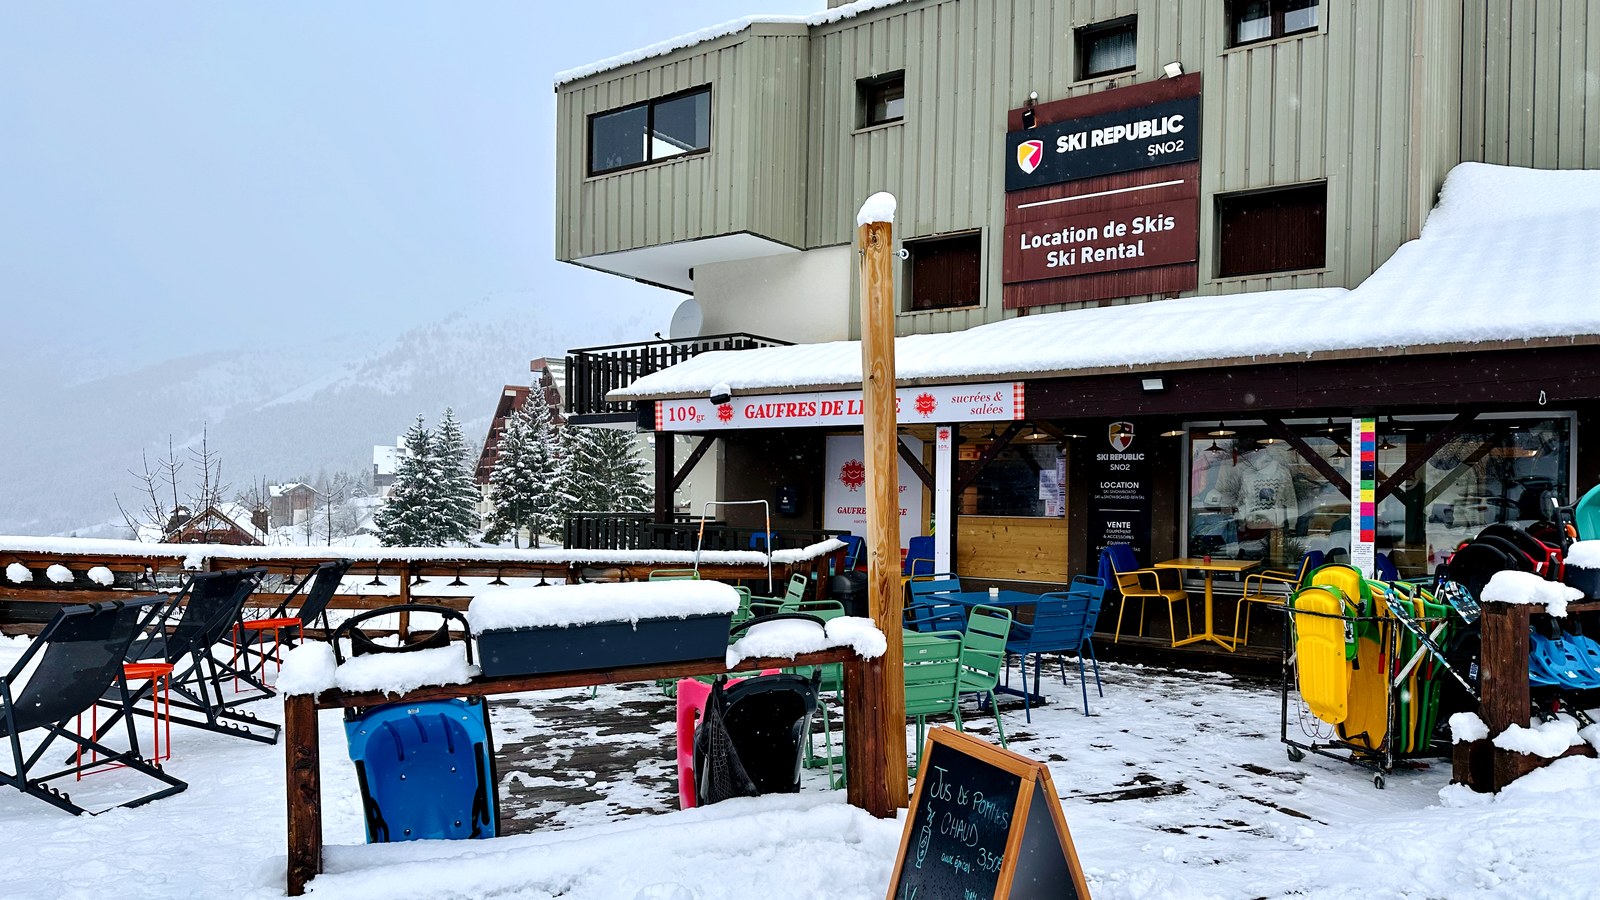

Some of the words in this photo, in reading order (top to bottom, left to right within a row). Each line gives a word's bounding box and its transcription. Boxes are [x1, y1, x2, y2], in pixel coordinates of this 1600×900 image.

[1056, 132, 1087, 154] SKI
[1091, 114, 1185, 148] REPUBLIC
[1147, 139, 1184, 157] SNO2
[1020, 226, 1098, 250] Location
[1103, 220, 1127, 238] de
[1131, 213, 1175, 236] Skis
[1046, 247, 1076, 268] Ski
[1080, 240, 1145, 264] Rental
[744, 401, 817, 419] GAUFRES
[820, 400, 844, 416] DE
[951, 391, 991, 403] sucrées
[993, 391, 1003, 401] &
[970, 403, 1004, 415] salées
[1096, 453, 1109, 461] SKI
[1110, 453, 1145, 461] REPUBLIC
[1100, 481, 1139, 489] LOCATION
[837, 506, 866, 515] GAUFRE
[1106, 521, 1131, 529] VENTE
[940, 811, 979, 848] CHAUD
